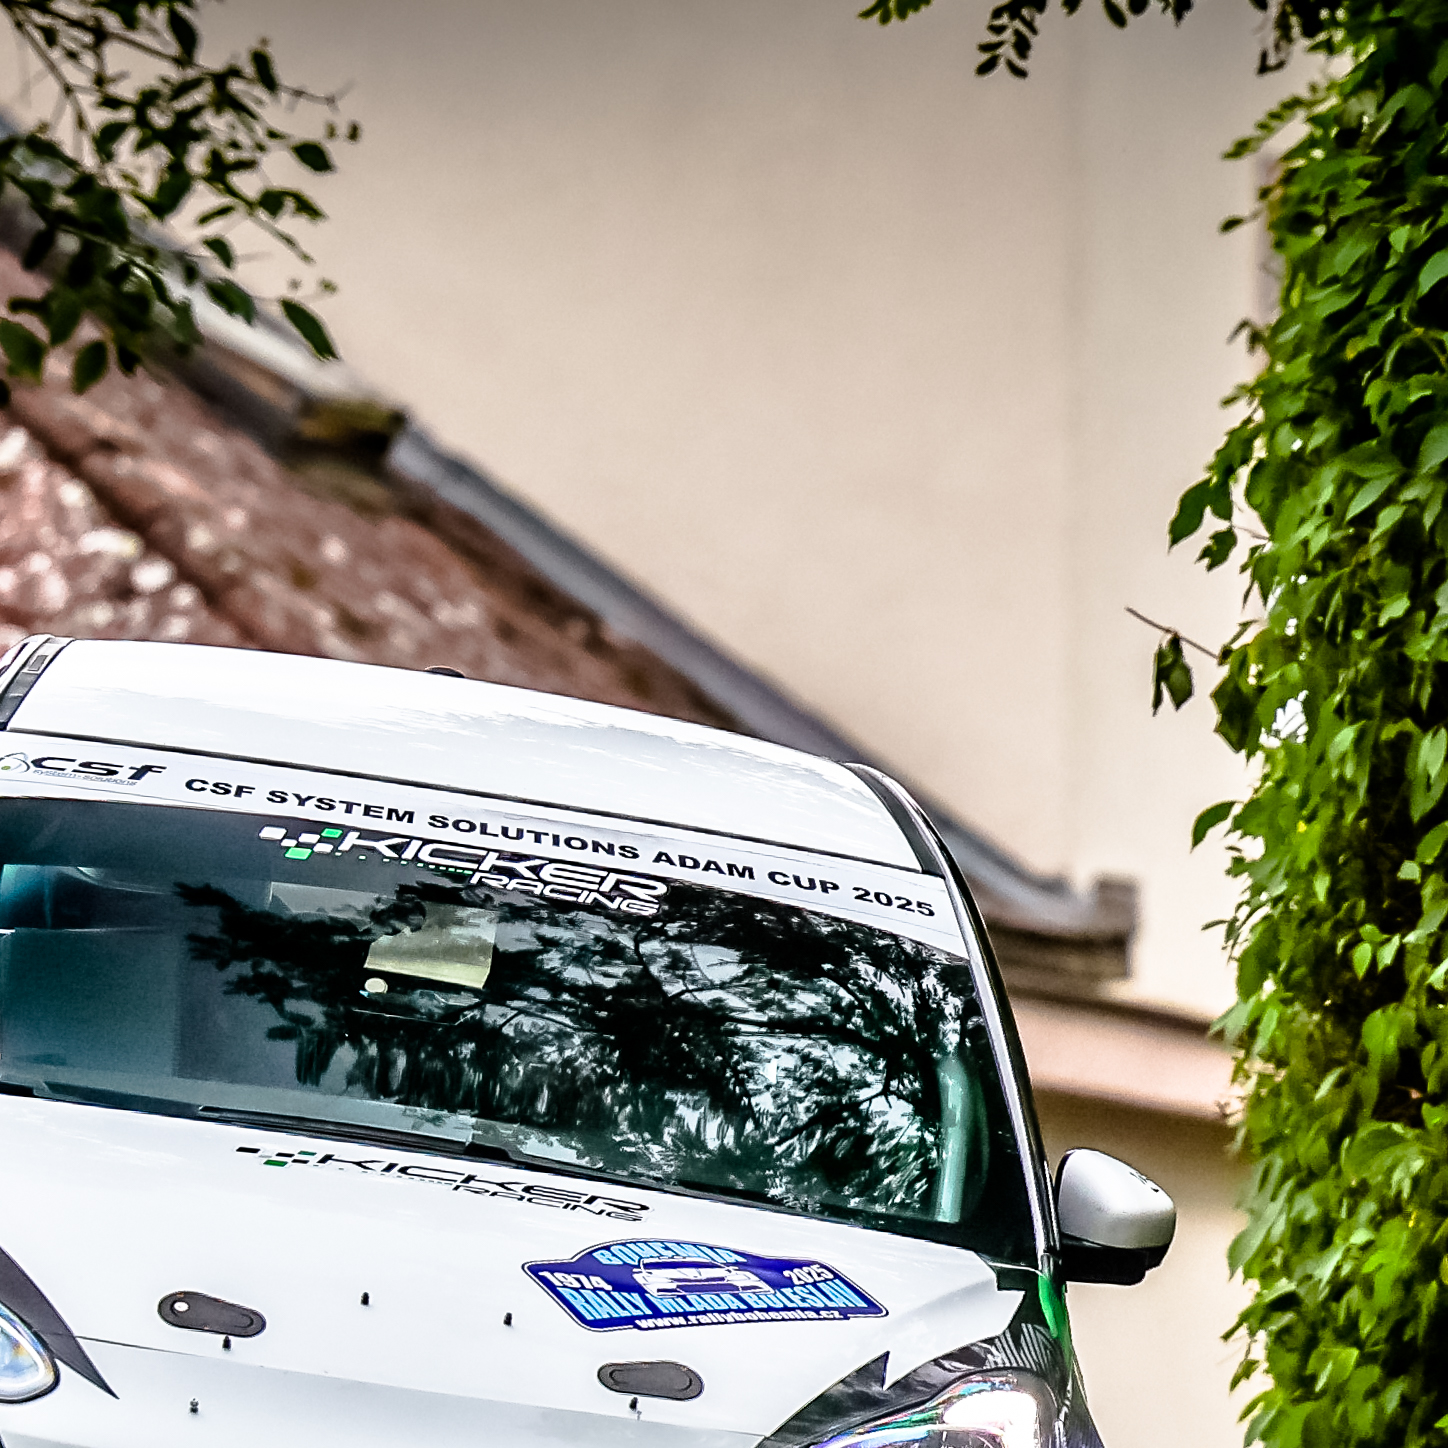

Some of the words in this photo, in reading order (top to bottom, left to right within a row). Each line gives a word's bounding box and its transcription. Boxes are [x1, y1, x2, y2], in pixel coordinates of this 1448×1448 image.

[185, 778, 256, 798] CSF
[266, 789, 415, 824] SYSTEM
[427, 814, 640, 860] SOLUTIONS
[652, 850, 756, 881] ADAM
[767, 870, 841, 895] CUP
[852, 886, 936, 917] 2025
[332, 831, 669, 902] KICKER
[469, 871, 660, 916] RACING
[316, 1153, 652, 1213] KICKER
[451, 1184, 643, 1222] RACING
[592, 1241, 748, 1266] BOHEMIA
[538, 1271, 613, 1291] 1974
[783, 1264, 835, 1286] 2025
[556, 1286, 653, 1321] RALLY
